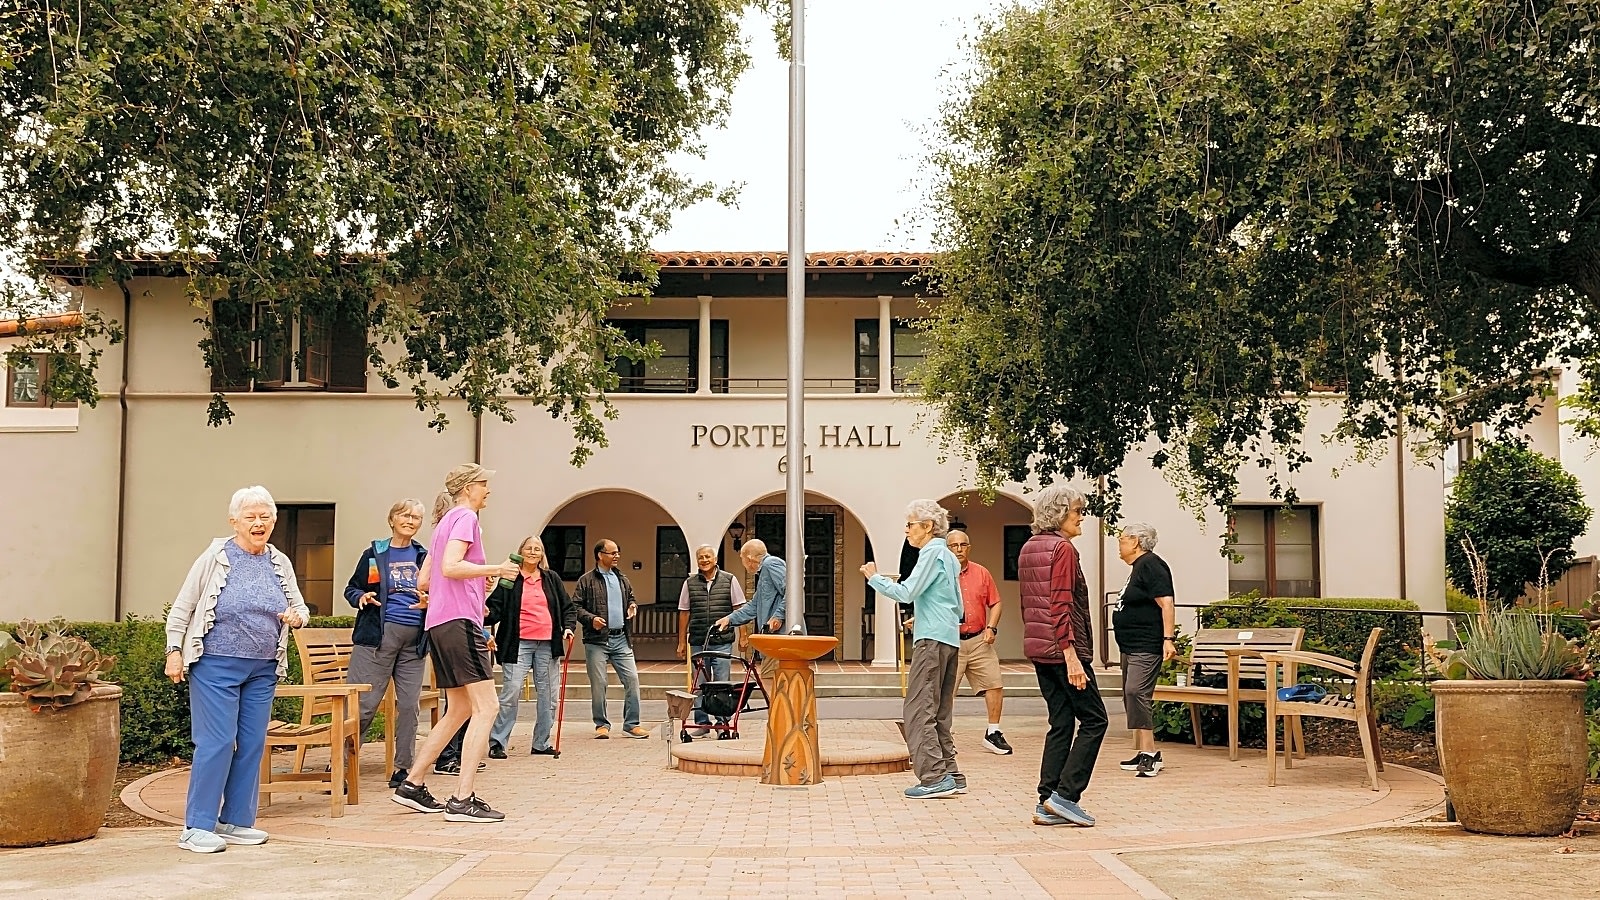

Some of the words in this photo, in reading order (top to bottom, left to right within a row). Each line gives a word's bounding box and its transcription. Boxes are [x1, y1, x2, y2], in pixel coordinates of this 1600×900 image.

[691, 424, 807, 448] PORTE
[819, 424, 902, 448] HALL
[777, 454, 815, 474] 61
